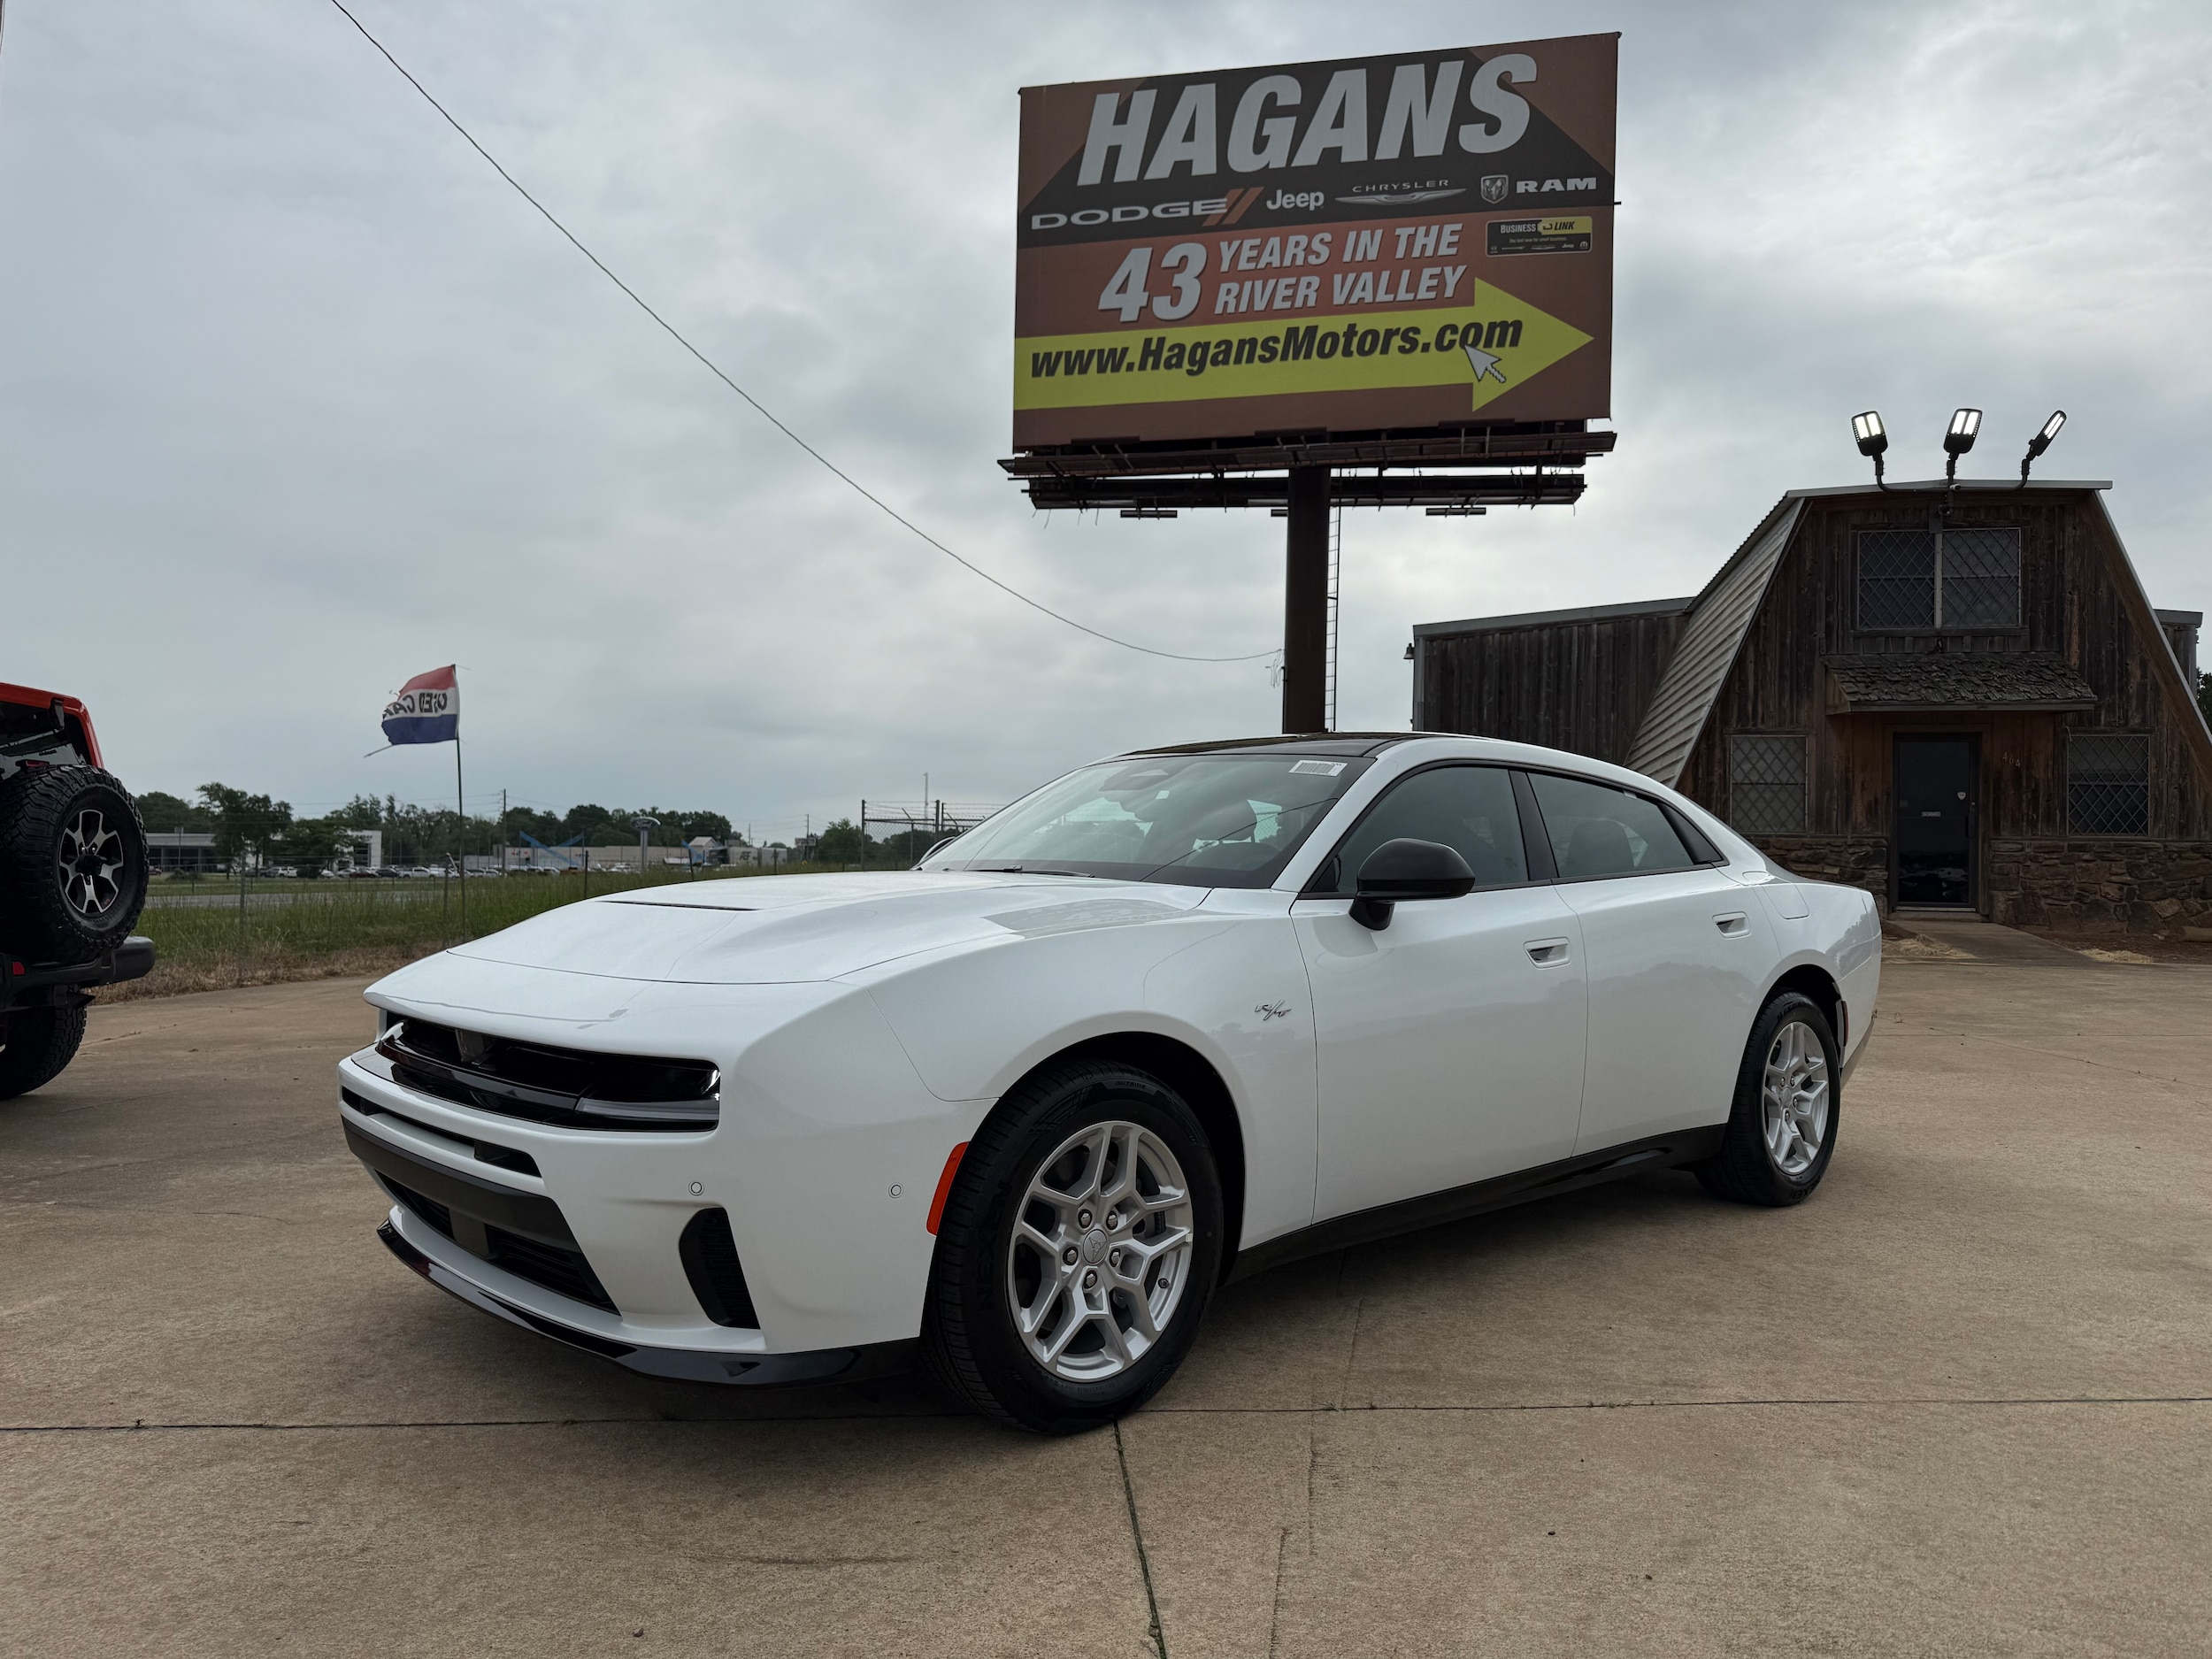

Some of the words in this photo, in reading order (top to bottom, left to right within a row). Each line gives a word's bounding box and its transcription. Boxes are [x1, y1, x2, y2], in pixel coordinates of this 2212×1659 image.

[1077, 53, 1538, 188] HAGANS
[1265, 188, 1325, 211] Jeep
[1351, 179, 1449, 194] CHRYSLER
[1516, 177, 1597, 194] RAM
[1031, 197, 1227, 231] DODGE
[1554, 221, 1575, 231] LINK
[1219, 232, 1333, 273] YEARS
[1342, 228, 1383, 264] IN
[1394, 223, 1463, 260] THE
[1098, 242, 1207, 323] 43
[1214, 275, 1321, 315] RIVER
[1333, 265, 1468, 306] VALLEY
[1031, 319, 1524, 378] www.HagansMotors.com
